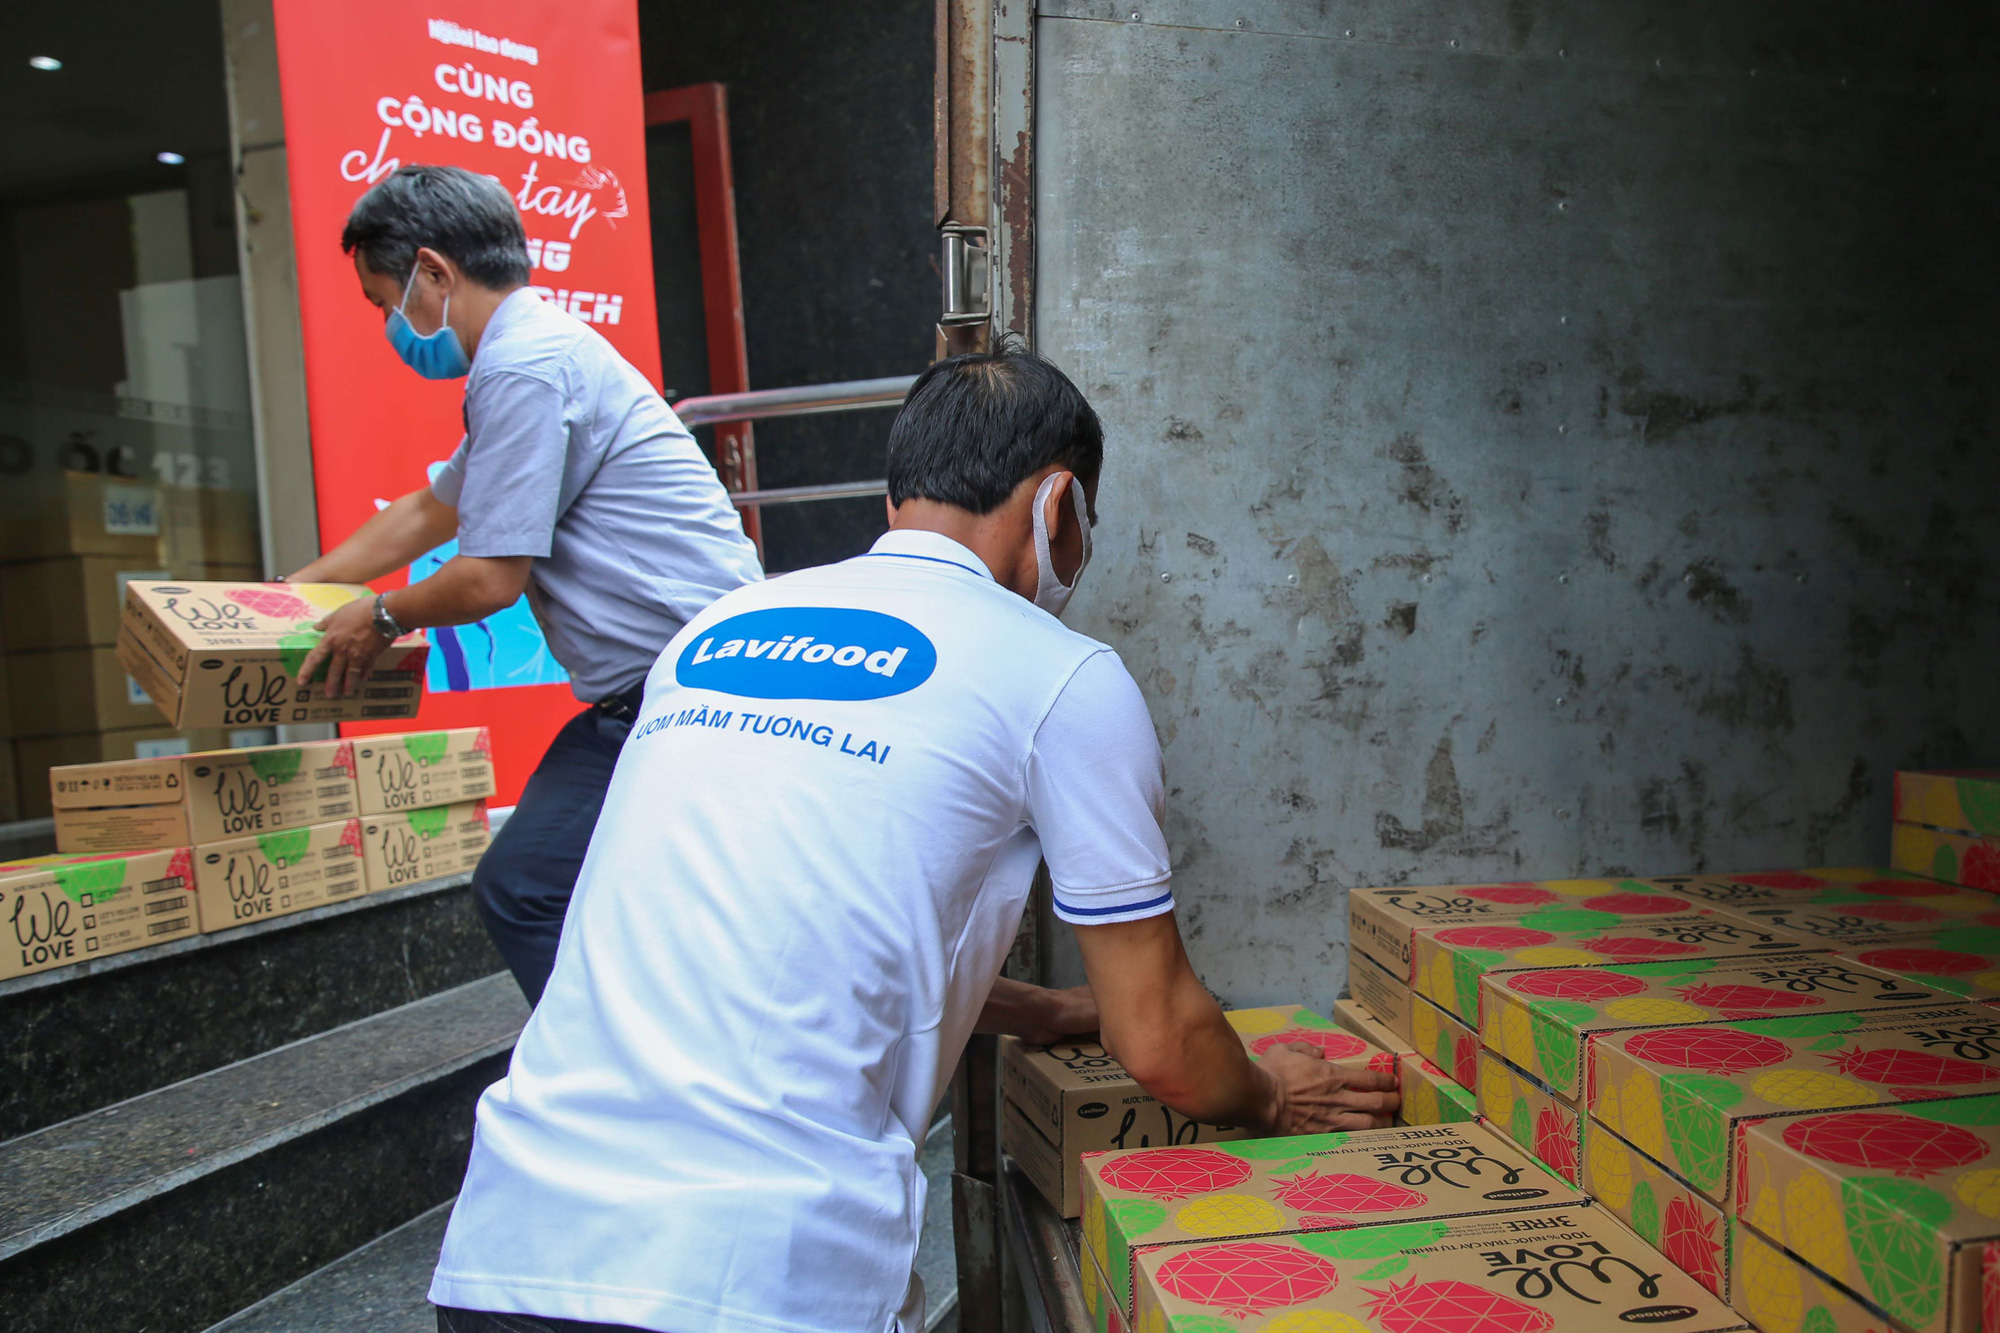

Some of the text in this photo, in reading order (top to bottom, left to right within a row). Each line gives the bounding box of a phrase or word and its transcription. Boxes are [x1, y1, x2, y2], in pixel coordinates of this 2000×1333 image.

[434, 62, 534, 109] CÙNG
[377, 95, 592, 164] CỘNG ĐỒNG
[516, 160, 597, 240] tay
[188, 621, 259, 630] LOVE
[691, 635, 909, 678] Lavifood
[220, 665, 288, 709] We
[223, 708, 281, 724] LOVE
[674, 704, 733, 729] MẦM
[739, 713, 834, 747] TƯƠNG
[840, 733, 891, 765] LAI
[375, 752, 418, 793] We
[213, 769, 265, 817] We
[383, 791, 416, 808] LOVE
[223, 813, 263, 834] LOVE
[381, 827, 420, 869] We
[223, 854, 275, 902] We
[387, 865, 419, 884] LOVE
[8, 891, 77, 947] We
[233, 897, 273, 919] LOVE
[22, 940, 75, 968] LOVE
[1750, 965, 1852, 980] LOVE
[1395, 1127, 1460, 1140] 3FREE
[1373, 1145, 1485, 1165] LOVE
[1377, 1156, 1526, 1189] We
[1502, 1215, 1578, 1233] 3FREE
[1479, 1241, 1612, 1267] LOVE
[1487, 1256, 1663, 1304] We
[1625, 1308, 1691, 1321] Lavifood
